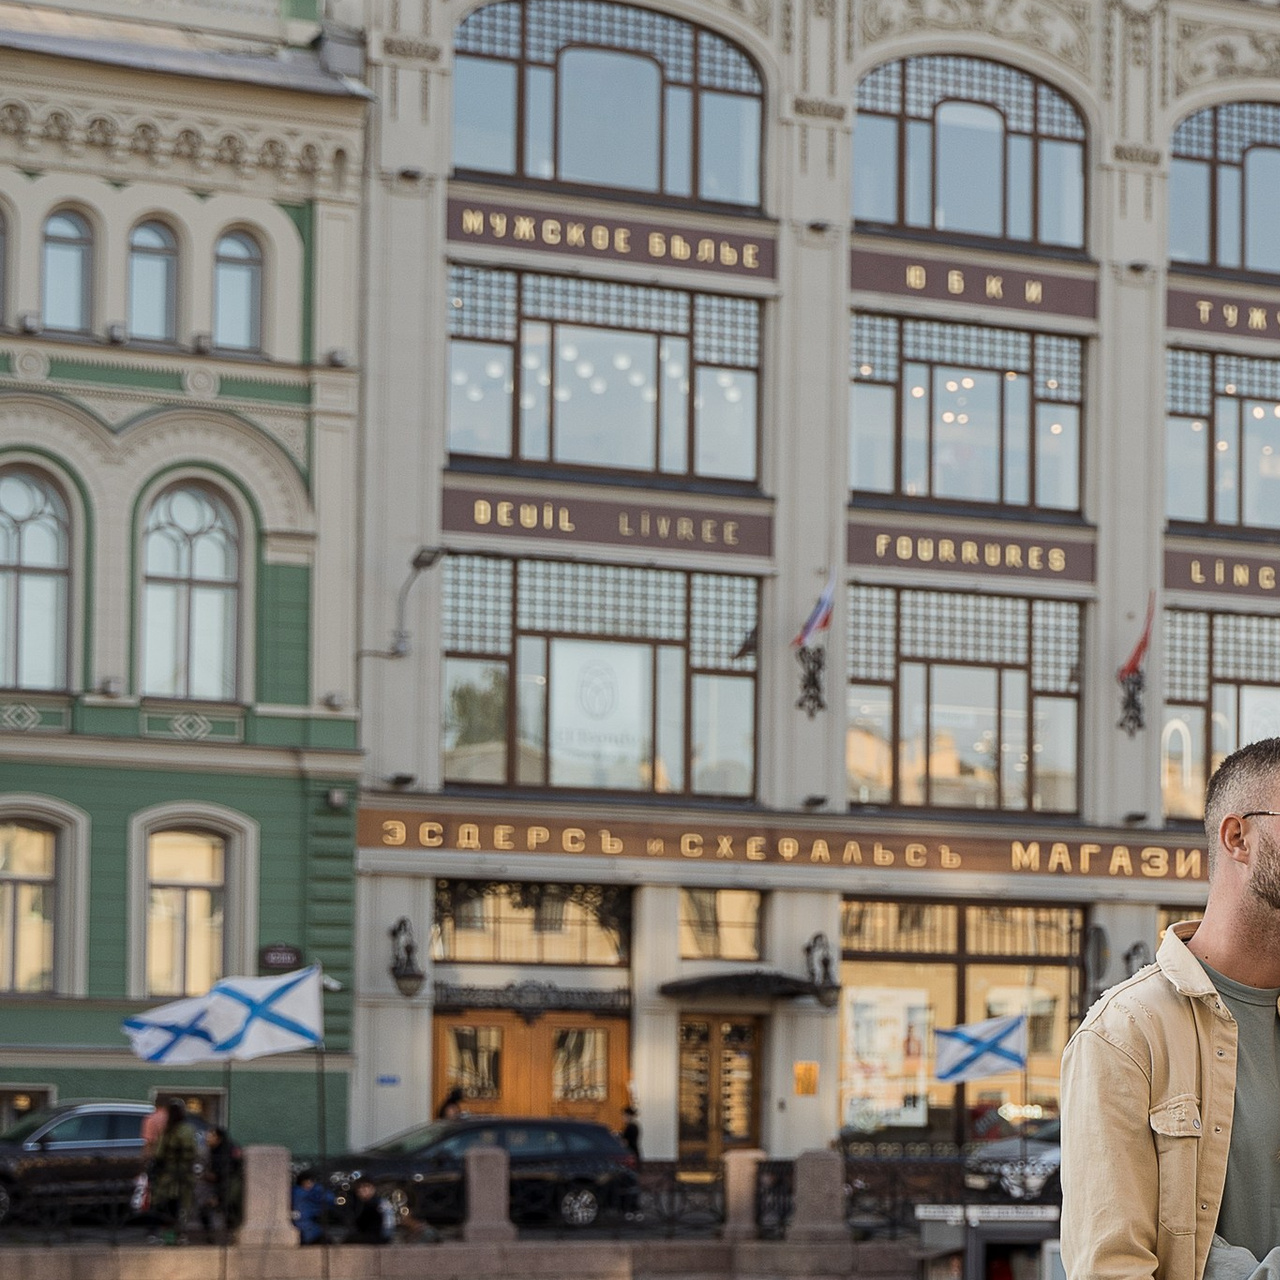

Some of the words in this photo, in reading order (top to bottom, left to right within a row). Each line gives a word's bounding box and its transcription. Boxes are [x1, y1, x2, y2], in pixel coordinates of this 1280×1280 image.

[463, 209, 631, 253] МУЖСКОЕ
[906, 265, 1042, 304] ЮБКИ
[474, 499, 575, 532] DEUIL
[619, 510, 739, 545] LIVREE
[876, 534, 1066, 571] FOURRURES
[382, 820, 623, 854] ЭСДЕРСЪ
[681, 833, 962, 868] СХЕФАЛЬСЪ
[1011, 840, 1200, 878] МАГАЗИ
